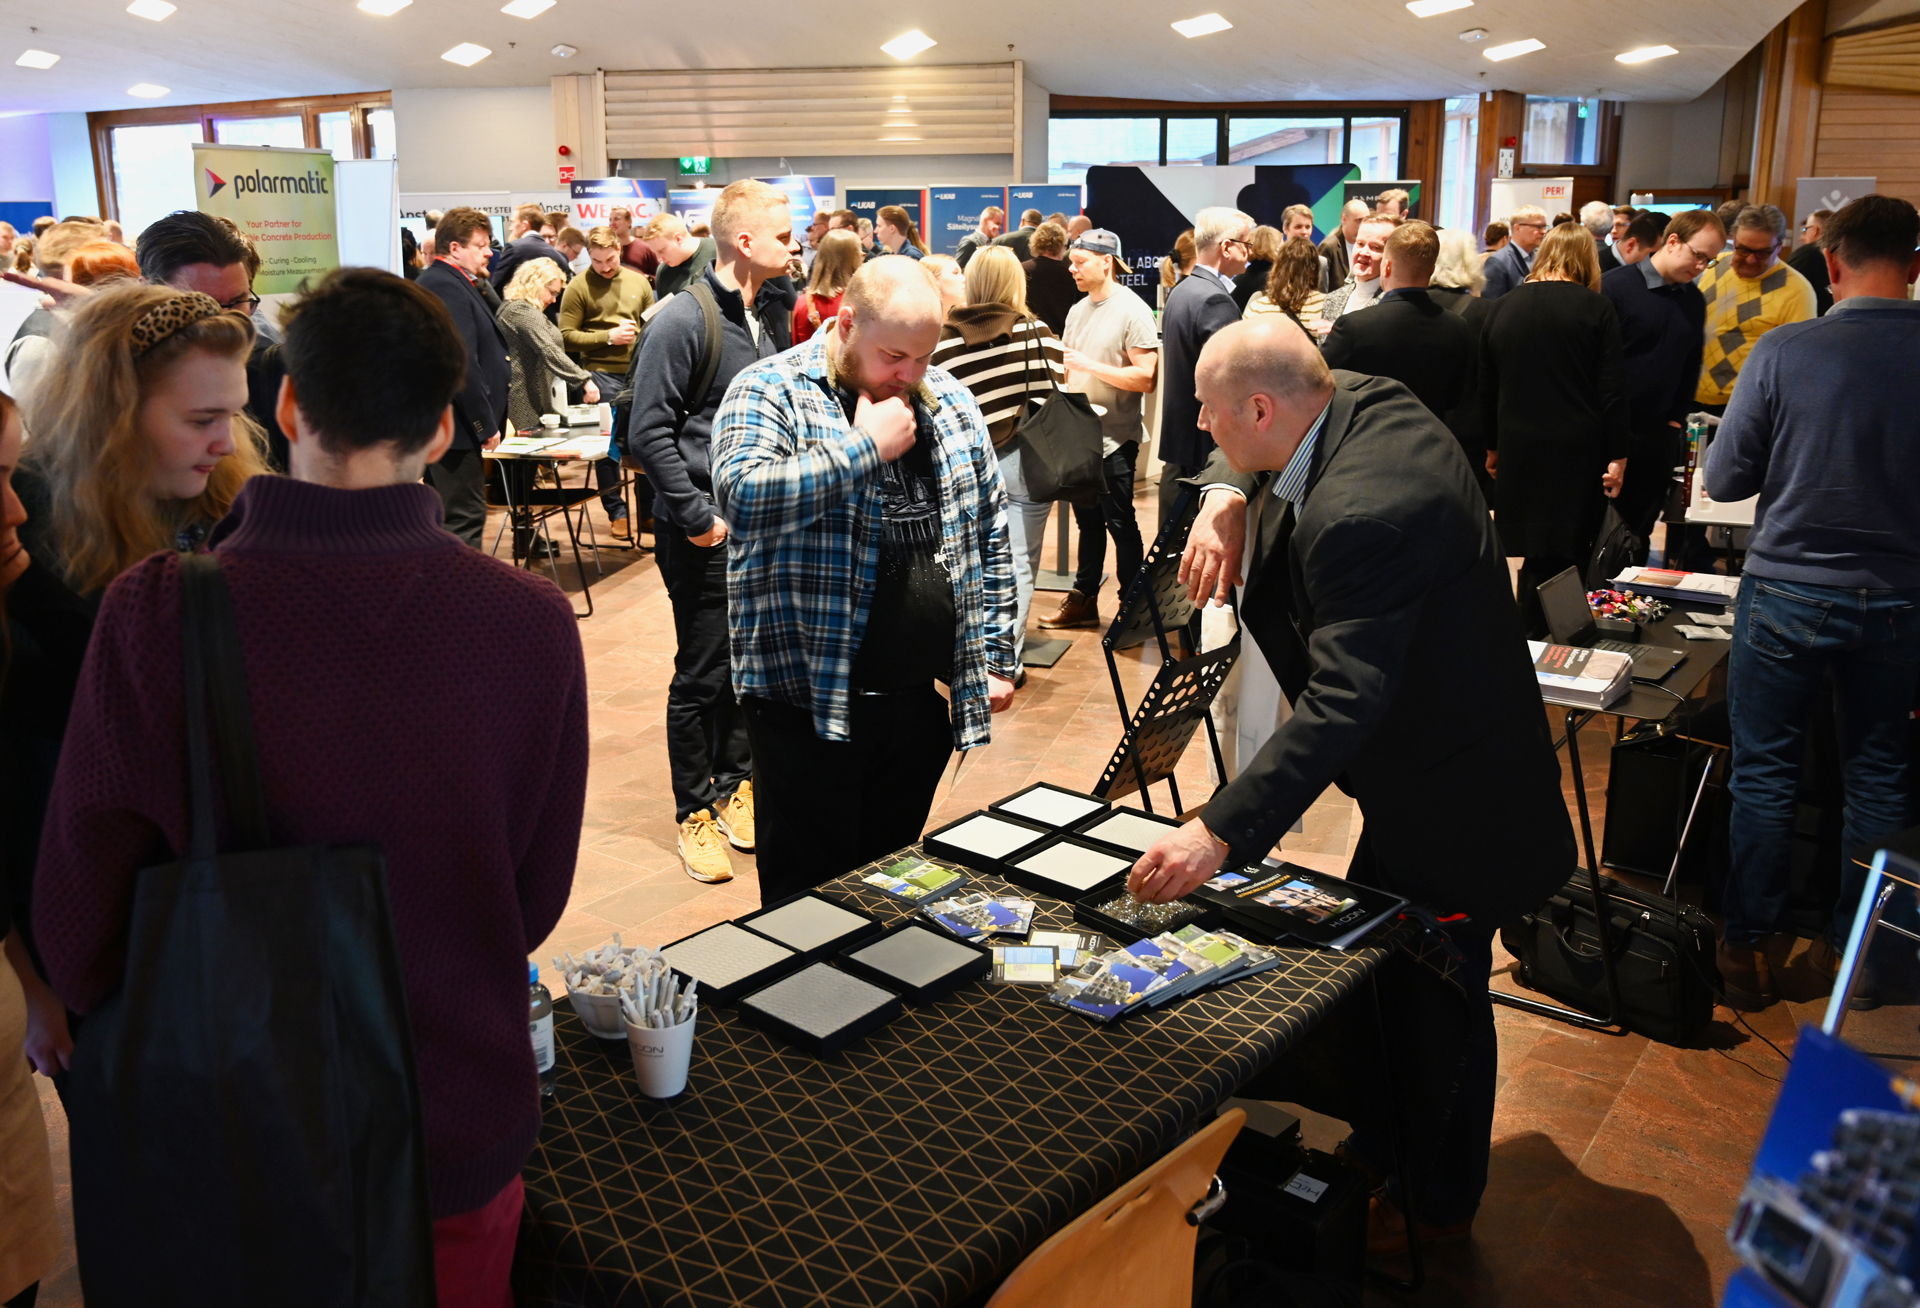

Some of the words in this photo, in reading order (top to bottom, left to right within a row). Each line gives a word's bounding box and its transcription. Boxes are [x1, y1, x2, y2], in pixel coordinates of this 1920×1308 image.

[234, 169, 328, 199] polarmatic
[1545, 187, 1564, 195] PERI
[857, 201, 876, 209] LKAB
[577, 203, 653, 219] WEAC.
[957, 215, 981, 223] Magna
[246, 220, 262, 228] Your
[264, 220, 290, 228] Partner
[291, 220, 302, 228] for
[261, 233, 293, 241] Concrete
[294, 232, 332, 241] Production
[268, 257, 290, 265] Curing
[293, 256, 317, 264] Cooling
[286, 267, 327, 275] Measurement
[1116, 273, 1148, 286] TEEL
